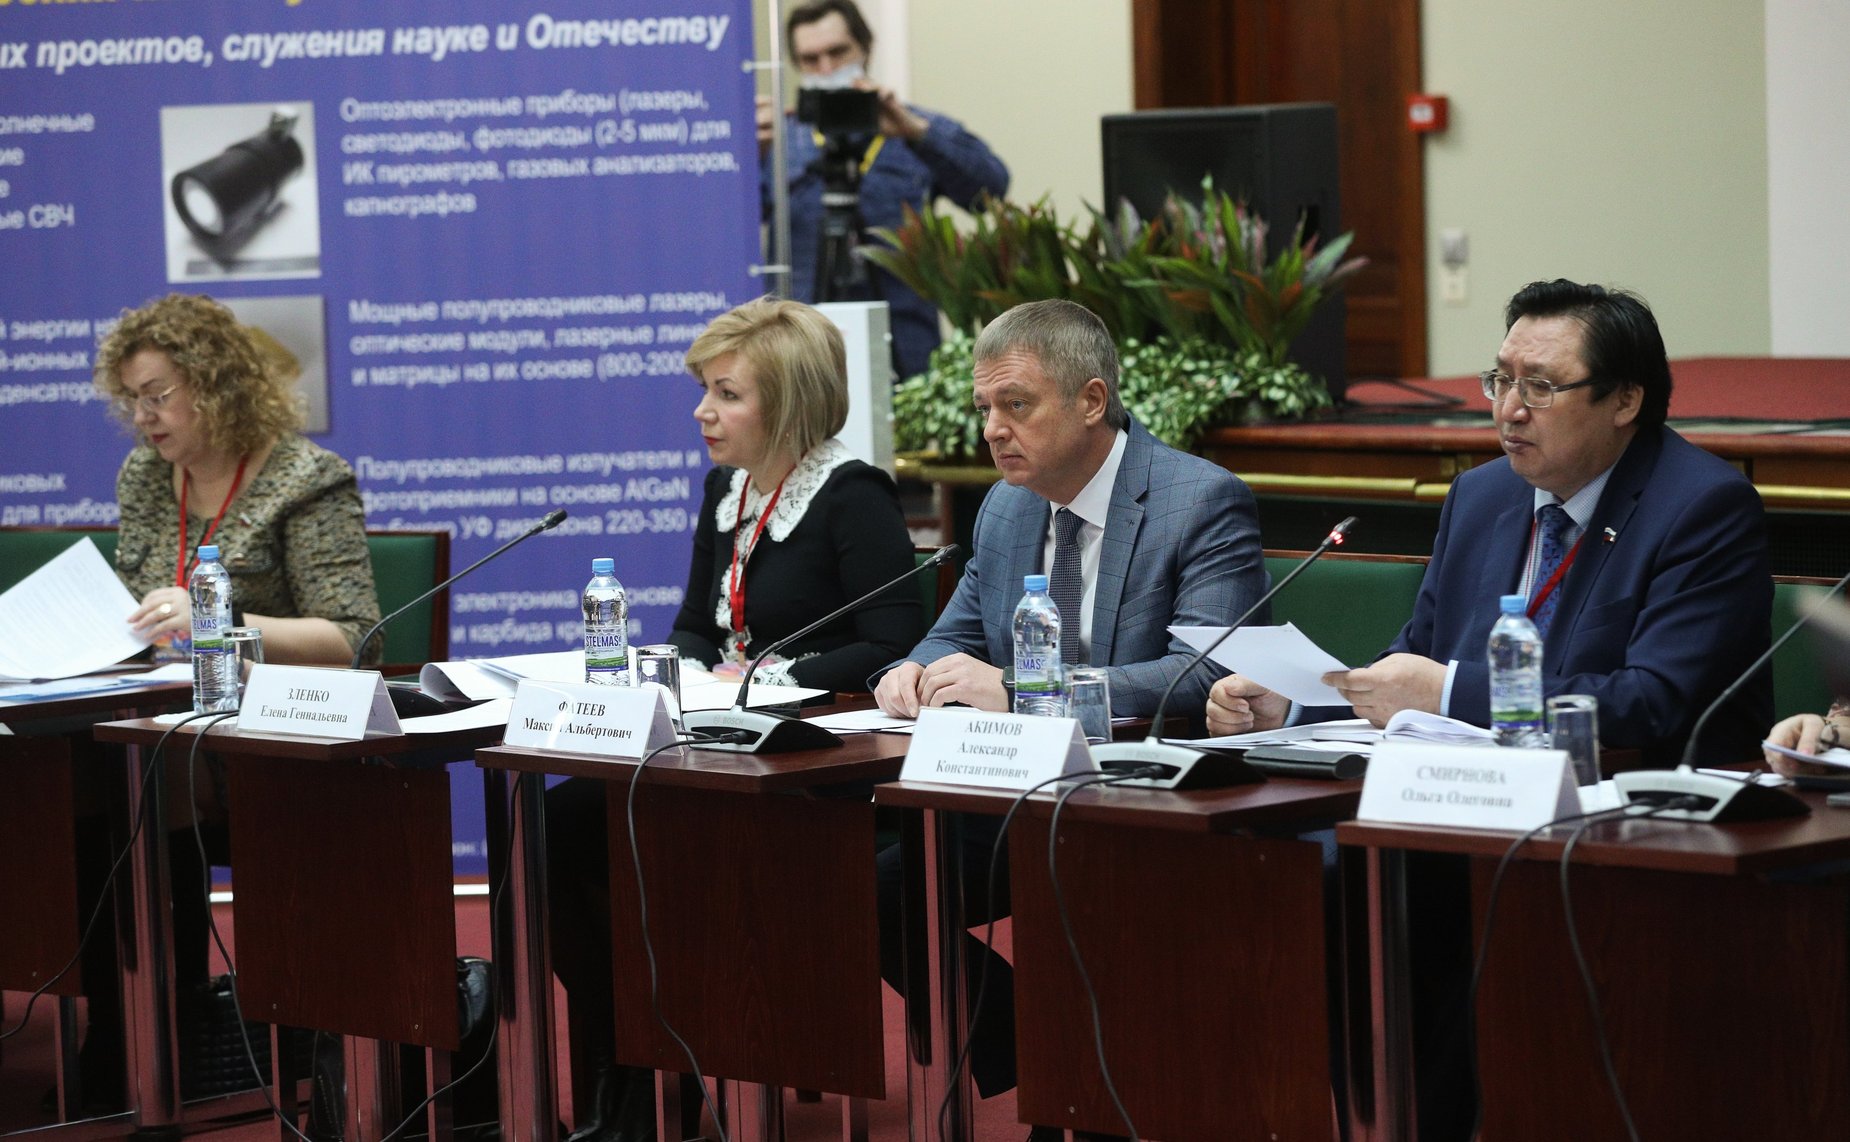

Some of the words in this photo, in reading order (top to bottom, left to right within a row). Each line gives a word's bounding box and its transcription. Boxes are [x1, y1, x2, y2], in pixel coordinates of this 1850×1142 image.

[36, 35, 213, 75] проектов,
[221, 28, 386, 68] служения
[392, 24, 489, 62] науке
[495, 23, 519, 50] и
[526, 12, 730, 52] Отечеству
[340, 97, 523, 122] Оптоэлектронные
[525, 88, 616, 119] приборы
[341, 131, 471, 155] светодиоды,
[472, 124, 592, 153] фотодиоды
[690, 119, 731, 144] для
[342, 160, 375, 185] ИК
[507, 157, 590, 180] газовых
[591, 151, 740, 178] анализаторов,
[28, 203, 75, 228] СВЧ
[348, 298, 439, 327] Мощные
[441, 294, 647, 325] полупроводниковые
[10, 320, 91, 344] энергии
[350, 331, 466, 356] оптические
[467, 329, 550, 355] модули,
[553, 325, 655, 351] лазерные
[351, 367, 367, 387] и
[368, 364, 462, 389] матрицы
[463, 361, 491, 382] на
[492, 360, 519, 381] их
[520, 358, 594, 381] основе
[355, 453, 565, 485] Полупроводниковые
[566, 450, 684, 477] излучатели
[520, 486, 547, 506] на
[549, 483, 623, 505] основе
[624, 476, 690, 502] AlGaN
[1, 503, 41, 527] для
[458, 514, 493, 540] УФ
[605, 507, 689, 535] 220-350
[454, 589, 579, 615] электроника
[451, 624, 466, 644] и
[468, 617, 554, 647] карбида
[288, 688, 330, 702] ЗЛЕНКО
[260, 705, 288, 718] Елена
[564, 722, 632, 740] Альбертович
[965, 720, 1023, 736] АКИМОВ
[957, 741, 1018, 760] Александр
[936, 760, 1029, 778] Константинович
